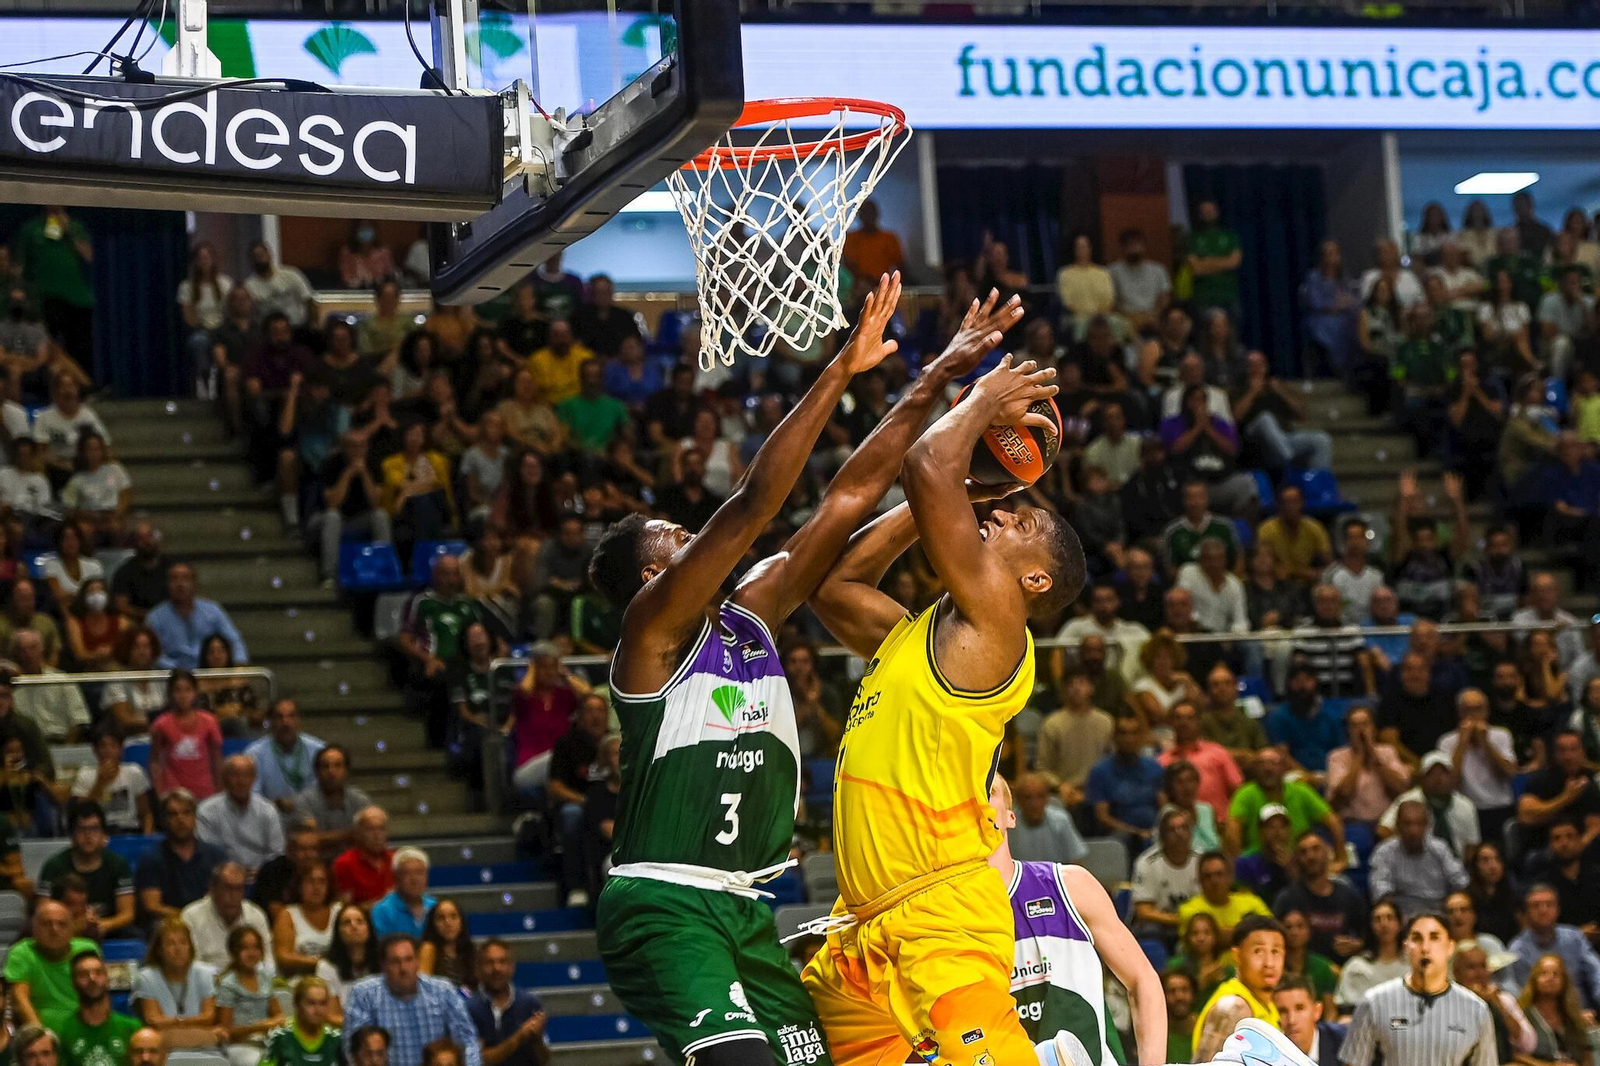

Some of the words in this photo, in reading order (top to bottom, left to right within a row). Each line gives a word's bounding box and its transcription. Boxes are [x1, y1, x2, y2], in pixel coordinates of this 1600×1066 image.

[11, 90, 417, 184] endesa
[714, 792, 742, 845] 3
[776, 1024, 798, 1036] sabor
[779, 1035, 788, 1044] a
[786, 1021, 821, 1048] má
[965, 1033, 980, 1043] acb
[782, 1042, 826, 1064] laga
